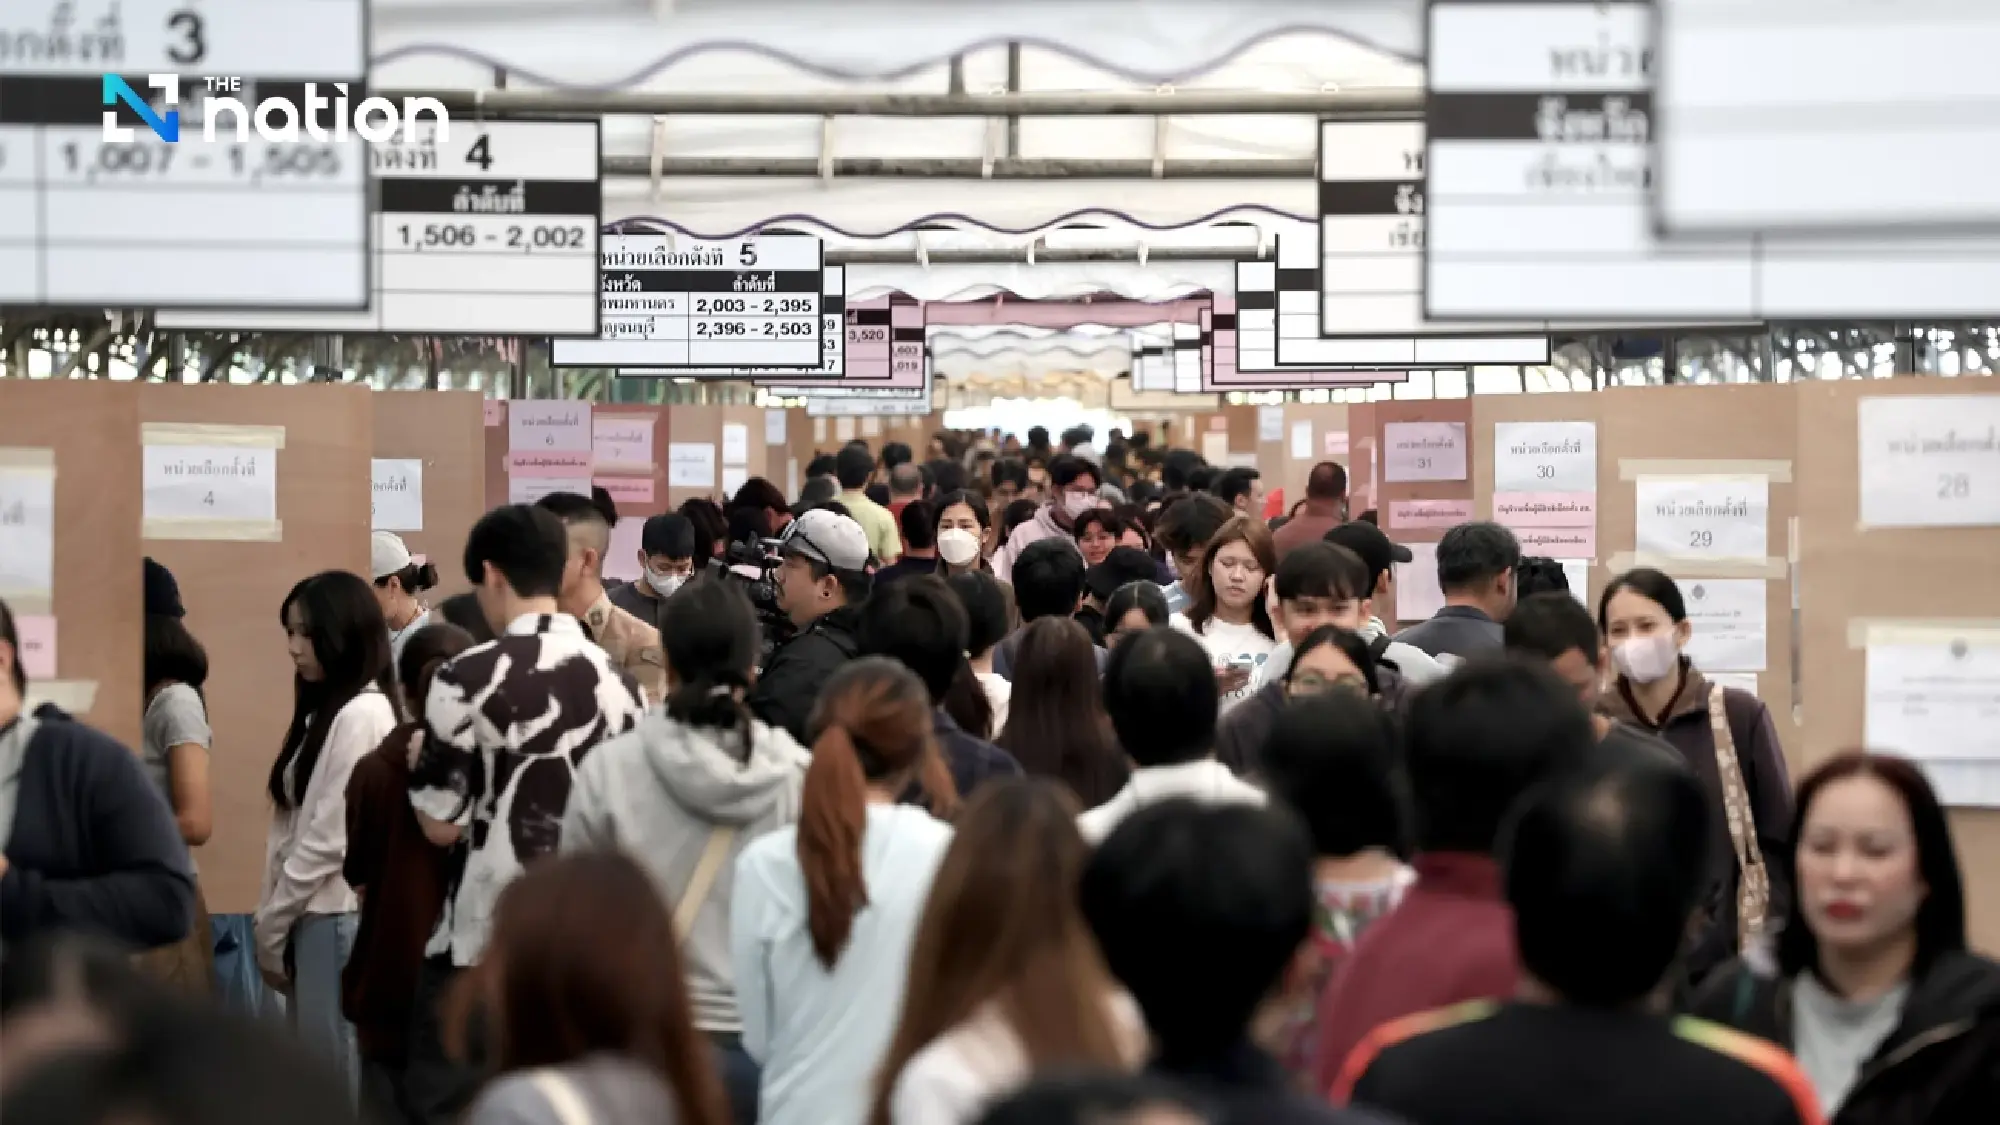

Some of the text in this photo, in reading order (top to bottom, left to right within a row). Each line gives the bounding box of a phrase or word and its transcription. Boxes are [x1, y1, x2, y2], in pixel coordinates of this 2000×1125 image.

[166, 9, 207, 64] 3
[466, 133, 494, 171] 4
[398, 225, 475, 252] 1,506
[507, 225, 584, 254] 2,002
[739, 243, 758, 267] 5
[696, 299, 746, 315] 2,003
[763, 299, 812, 316] 2,395
[696, 322, 746, 338] 2,396
[763, 322, 812, 339] 2,503
[1416, 456, 1433, 469] 31
[1536, 464, 1555, 479] 30
[203, 490, 215, 506] 4
[1690, 530, 1713, 548] 29
